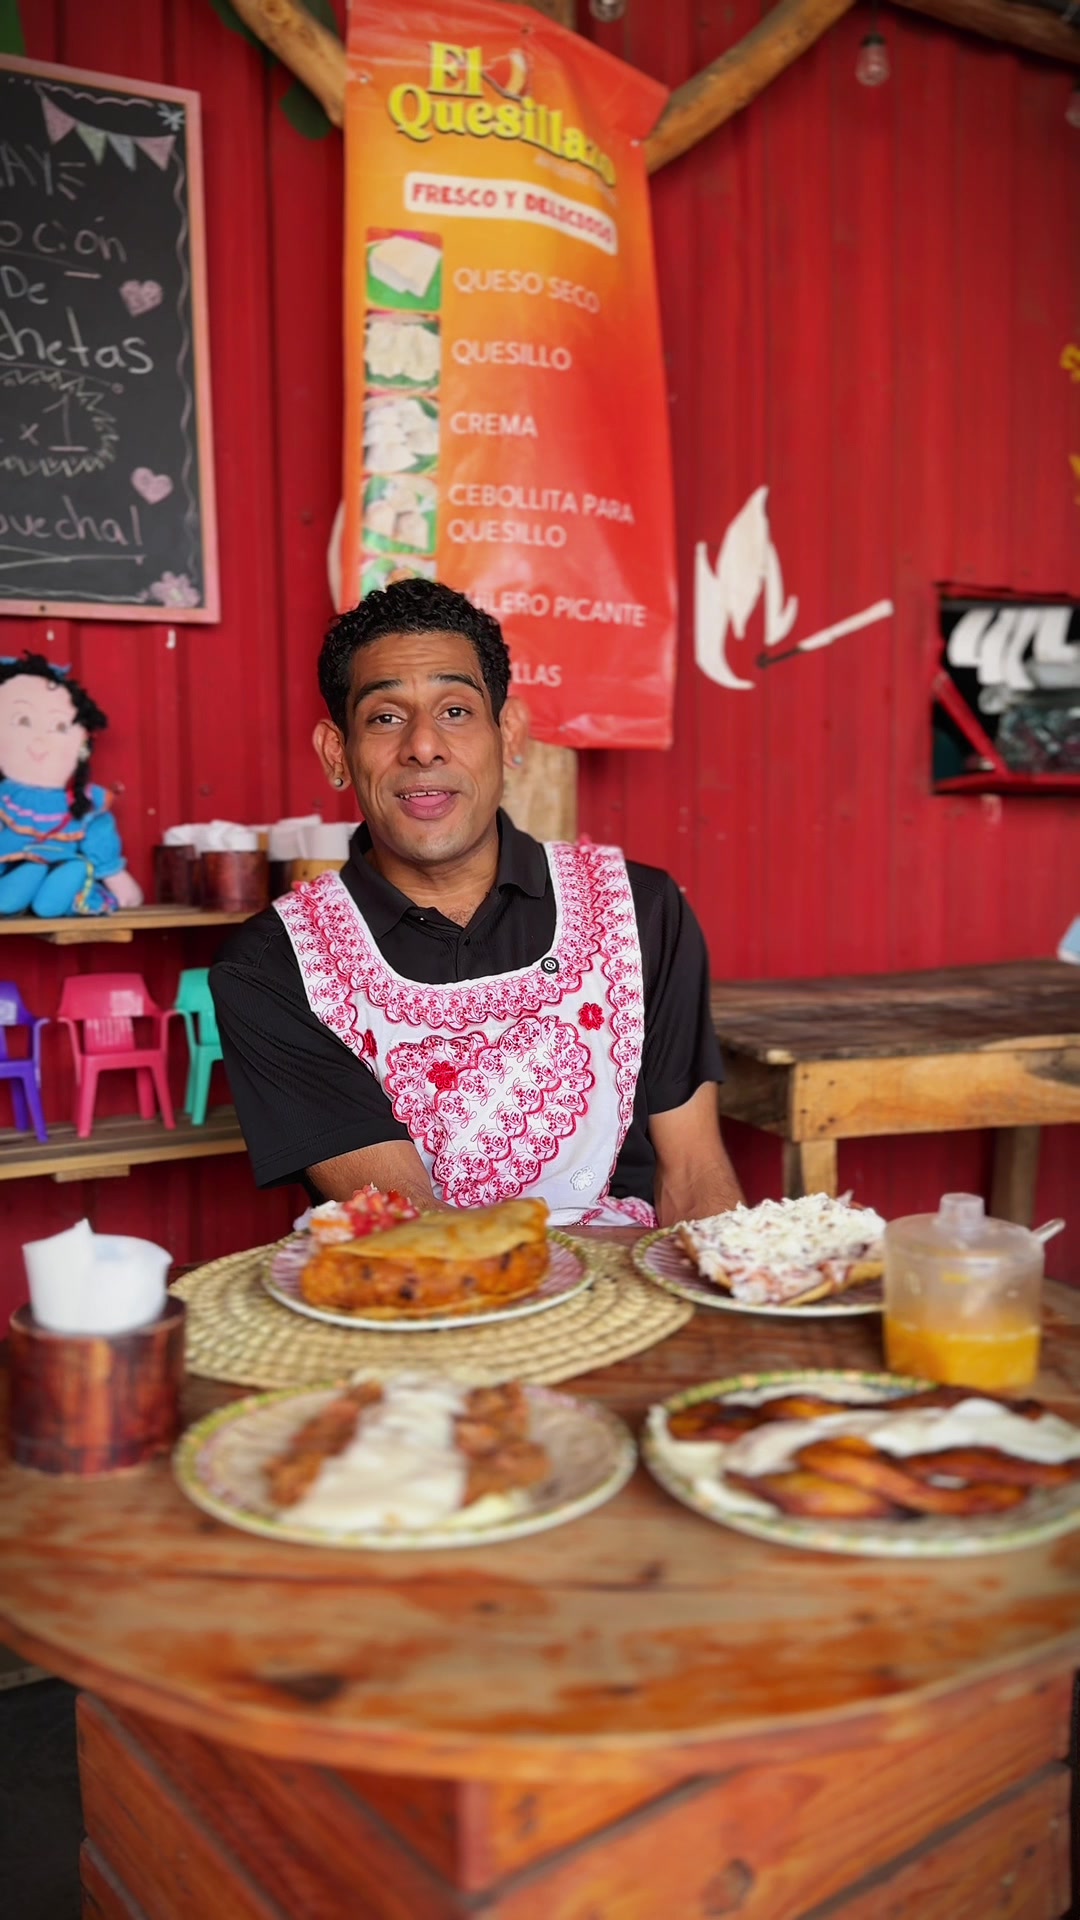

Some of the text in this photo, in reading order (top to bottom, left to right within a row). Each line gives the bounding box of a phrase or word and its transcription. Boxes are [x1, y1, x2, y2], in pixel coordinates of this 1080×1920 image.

[428, 41, 484, 98] El
[411, 182, 498, 208] FRESCO
[504, 190, 518, 209] Y
[453, 267, 600, 314] QUESO SECO
[451, 338, 572, 371] QUESILLO
[450, 411, 538, 437] CREMA
[448, 483, 636, 525] CEBOLLITA PARA
[447, 518, 567, 548] QUESILLO
[553, 596, 647, 627] PICANTE
